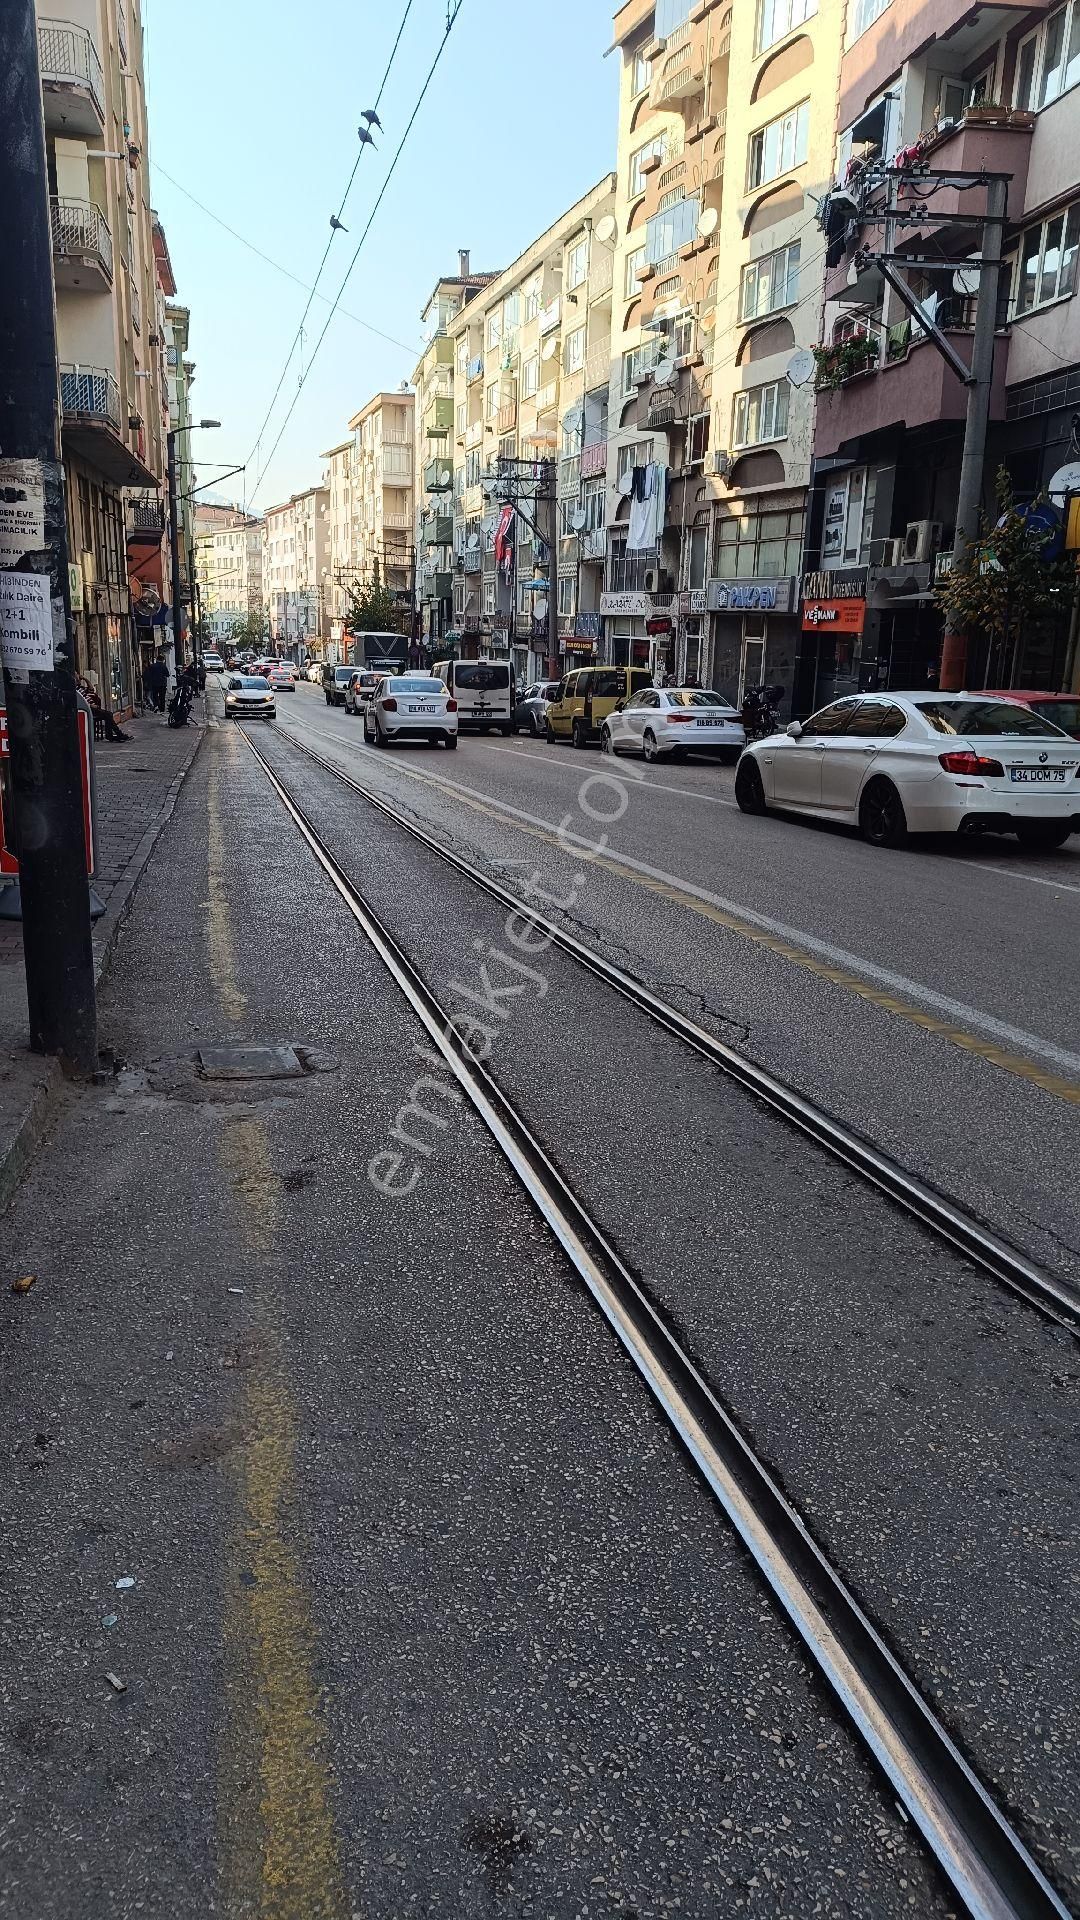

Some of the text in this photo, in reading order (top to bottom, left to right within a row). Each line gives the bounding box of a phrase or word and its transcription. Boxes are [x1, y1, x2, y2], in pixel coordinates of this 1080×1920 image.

[17, 510, 34, 519] EVE
[16, 592, 44, 603] Daire
[5, 608, 26, 621] 2+1
[24, 647, 34, 655] 59
[36, 648, 47, 656] 76
[1016, 770, 1027, 781] 34
[1053, 770, 1065, 781] 75
